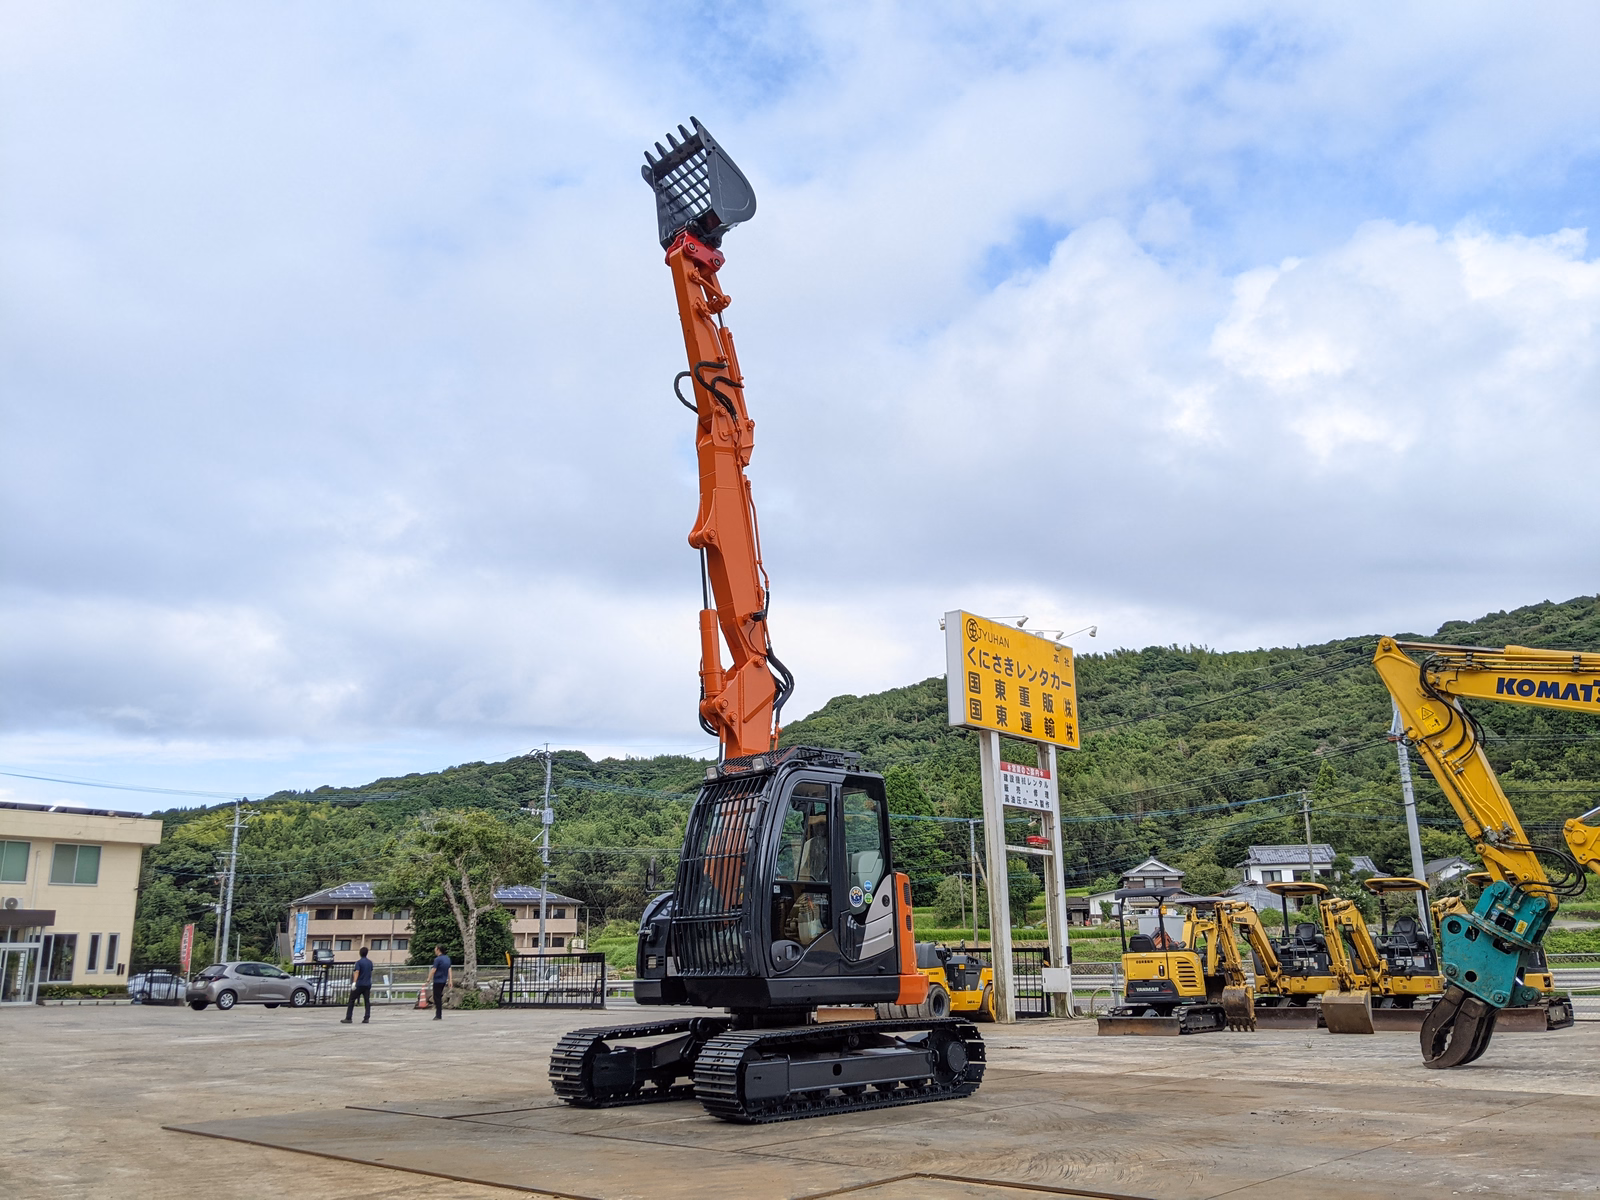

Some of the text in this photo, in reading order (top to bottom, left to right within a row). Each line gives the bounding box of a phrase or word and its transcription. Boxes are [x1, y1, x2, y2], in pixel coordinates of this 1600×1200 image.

[977, 627, 1010, 648] JYUHAN
[967, 646, 1072, 690] くにさきレンタカー
